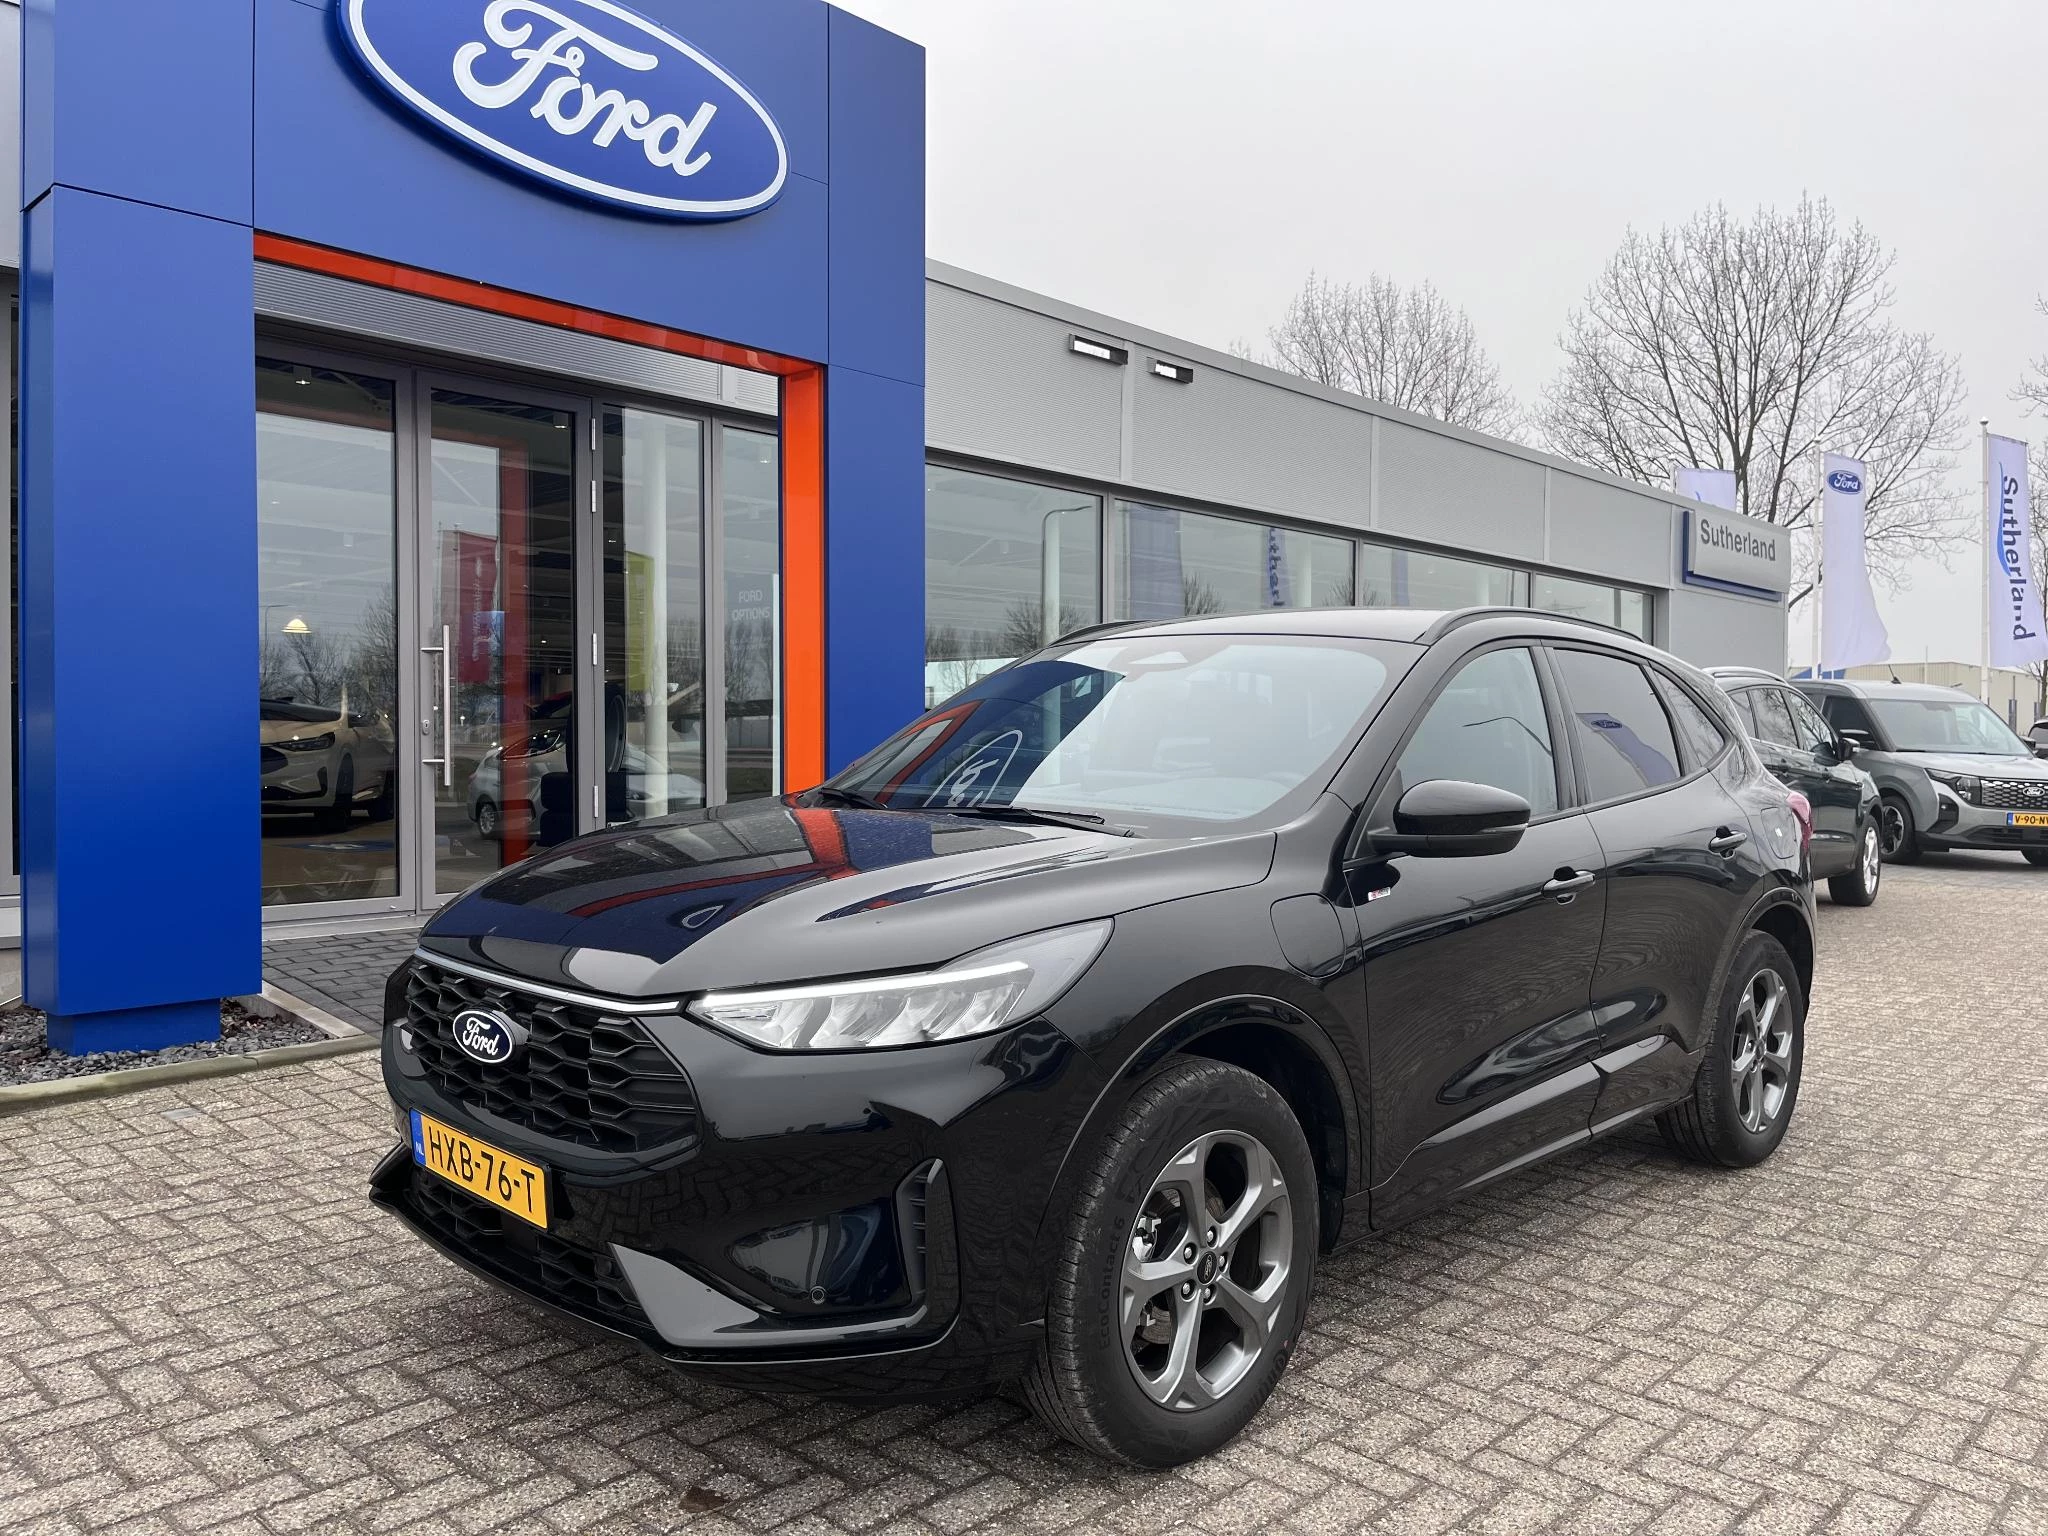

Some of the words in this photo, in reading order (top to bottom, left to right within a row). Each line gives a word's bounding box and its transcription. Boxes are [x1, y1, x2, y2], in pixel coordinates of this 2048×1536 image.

[453, 0, 718, 176] Ford
[1833, 472, 1859, 490] Ford
[1700, 518, 1776, 561] Sutherland
[2003, 475, 2036, 640] Sutherland
[738, 589, 763, 603] FORD
[731, 606, 770, 621] OPTIONS
[2015, 815, 2048, 825] V-90-N
[462, 1016, 499, 1056] Ford
[415, 1143, 425, 1157] NL
[428, 1126, 536, 1214] HXB-76-T
